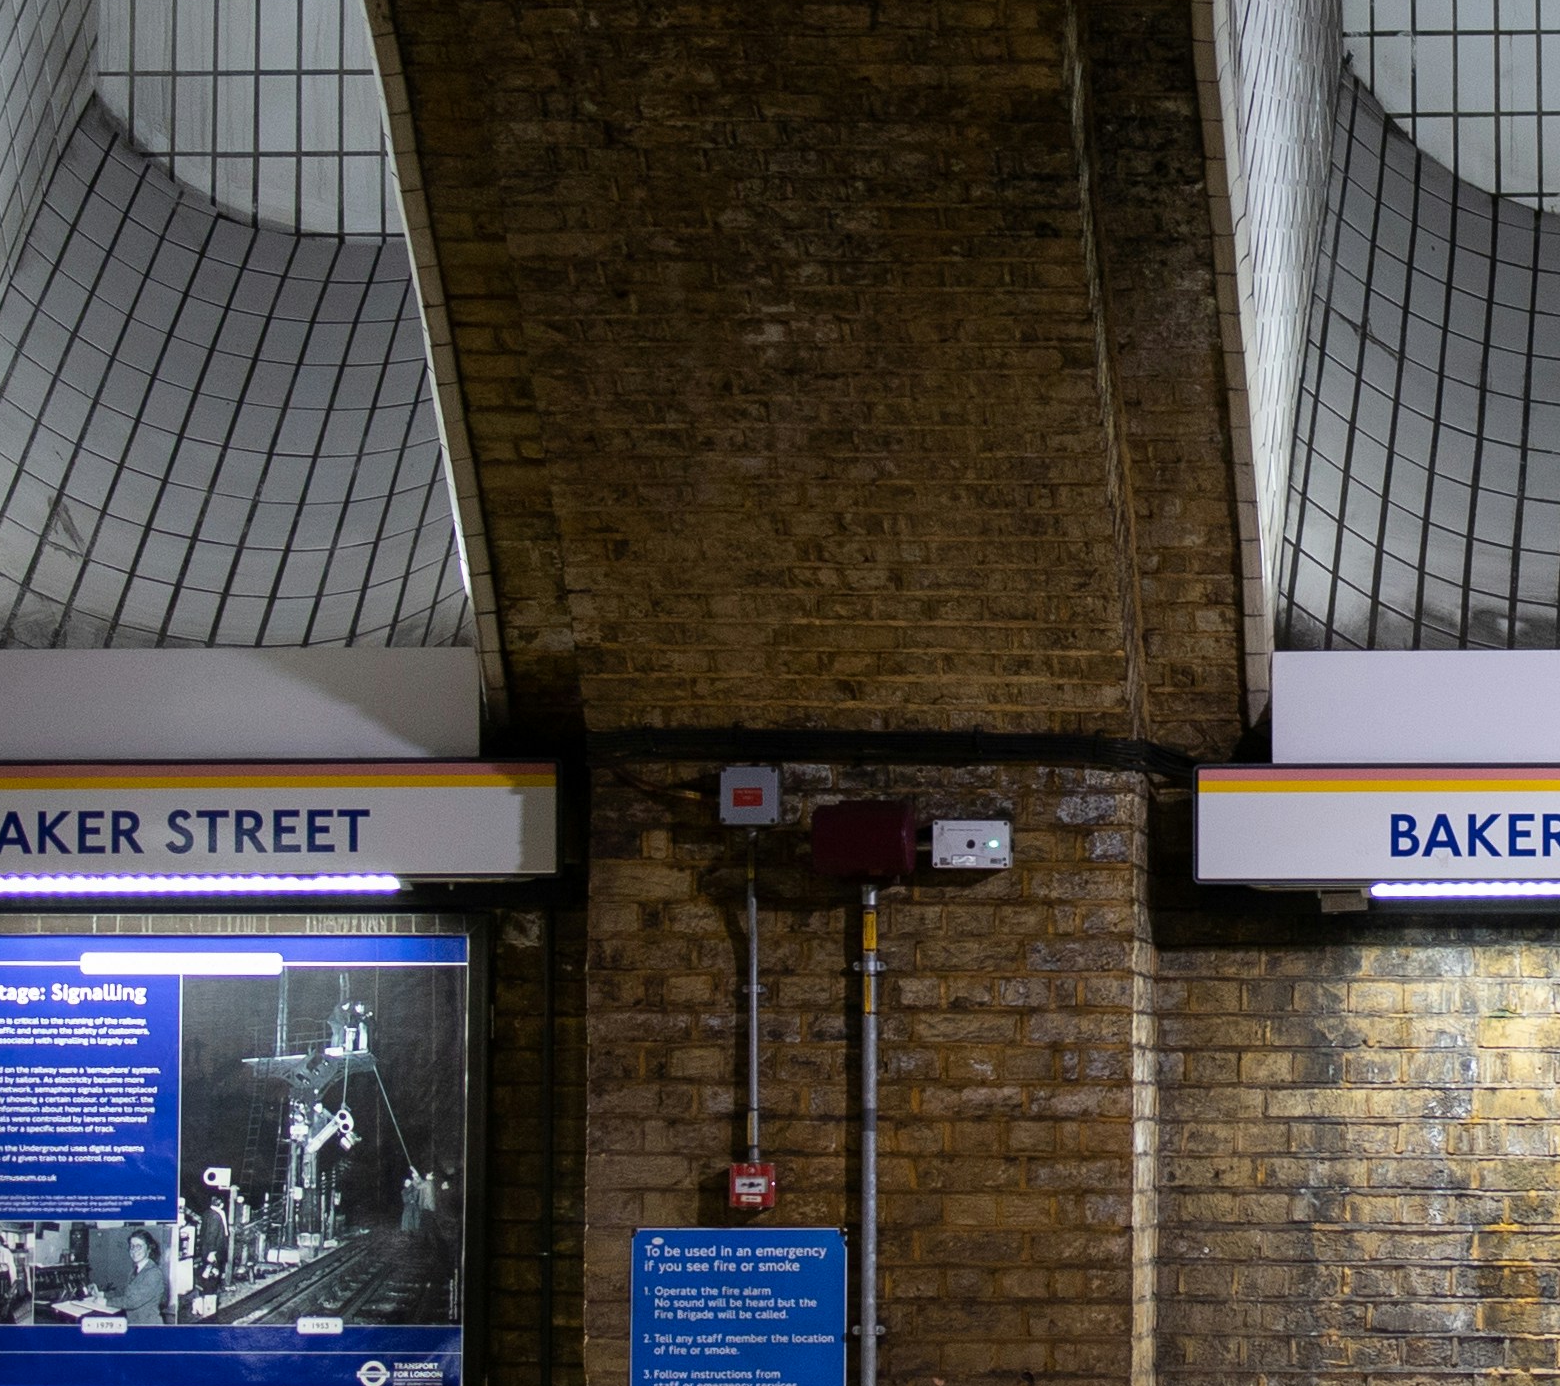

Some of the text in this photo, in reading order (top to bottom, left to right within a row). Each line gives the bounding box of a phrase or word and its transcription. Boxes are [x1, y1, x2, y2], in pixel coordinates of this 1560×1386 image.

[166, 809, 370, 854] STREET
[51, 983, 147, 1004] Signalling
[645, 1245, 827, 1259] To be used in an emergency
[645, 1260, 800, 1274] if you see fire or smoke
[655, 1286, 697, 1297] Operate
[701, 1287, 718, 1295] the
[722, 1286, 740, 1295] fire
[743, 1287, 771, 1295] alarm
[655, 1298, 817, 1307] No sound will be heard but the
[655, 1310, 788, 1321] Fire Brigade will be called.
[654, 1334, 672, 1343] Tell
[676, 1336, 693, 1345] any
[697, 1334, 722, 1343] staff
[726, 1334, 768, 1343] member
[771, 1334, 789, 1343] the
[792, 1334, 834, 1343] location
[654, 1345, 665, 1354] of
[669, 1345, 687, 1355] fire
[705, 1346, 739, 1355] smoke.
[654, 1370, 688, 1379] Follow
[691, 1370, 752, 1379] instructions
[756, 1369, 780, 1379] from
